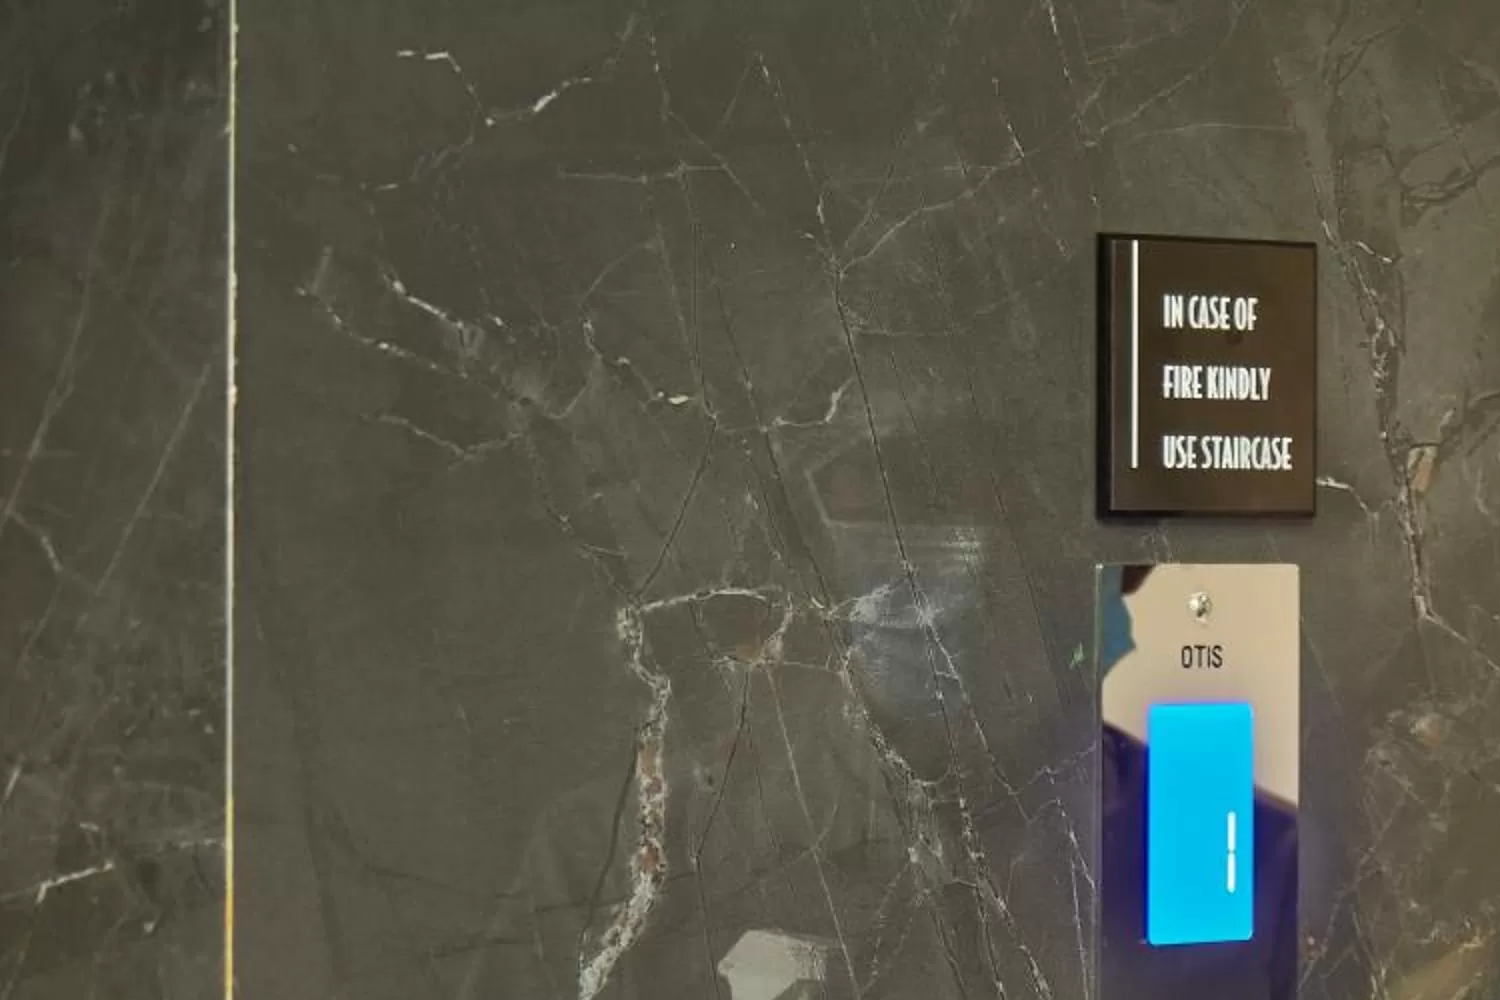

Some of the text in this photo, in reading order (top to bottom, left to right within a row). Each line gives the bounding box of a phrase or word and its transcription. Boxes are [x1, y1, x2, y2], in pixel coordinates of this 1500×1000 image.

[1163, 295, 1258, 330] IN CASE OF
[1163, 365, 1271, 400] FIRE KINDLY
[1163, 436, 1293, 470] USE STAIRCASE
[1181, 645, 1223, 669] OTIS
